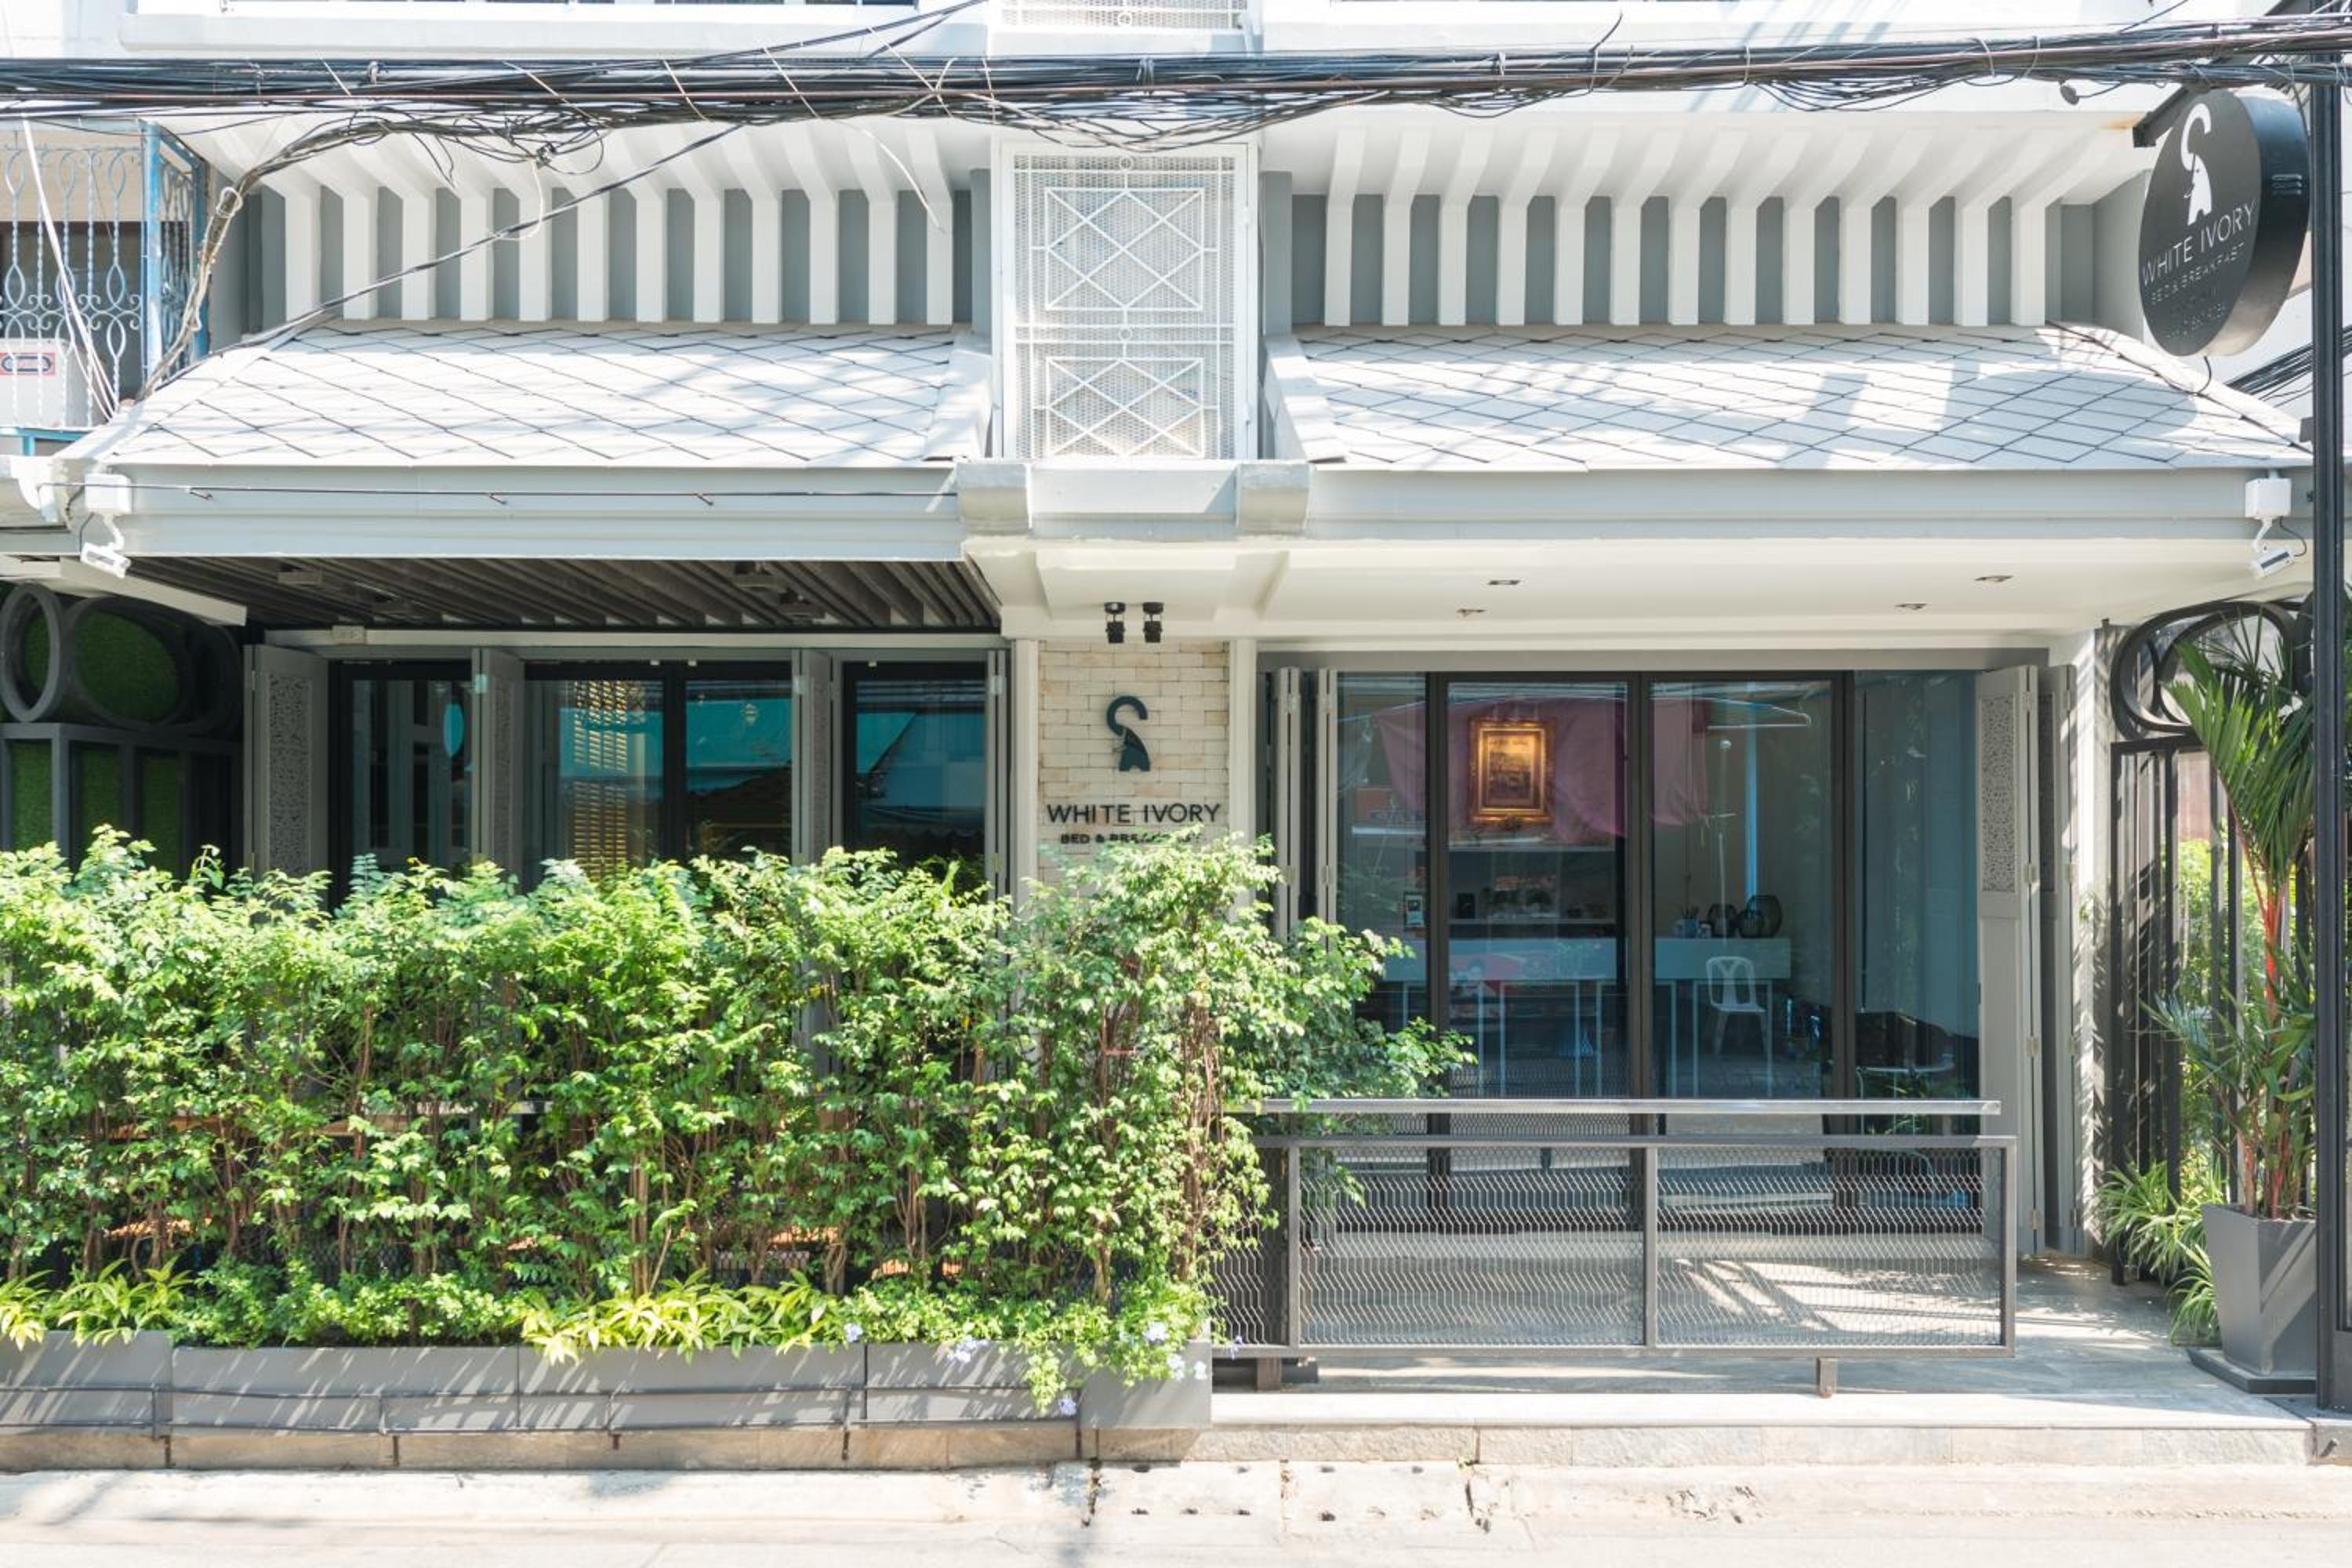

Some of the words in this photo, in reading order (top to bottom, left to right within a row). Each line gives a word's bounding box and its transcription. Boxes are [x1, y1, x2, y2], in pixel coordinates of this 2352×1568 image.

[2142, 236, 2194, 287] WHITE
[2201, 199, 2256, 252] IVORY
[1047, 804, 1131, 823] WHITE
[1144, 803, 1221, 823] IVORY
[1060, 833, 1091, 844] BED
